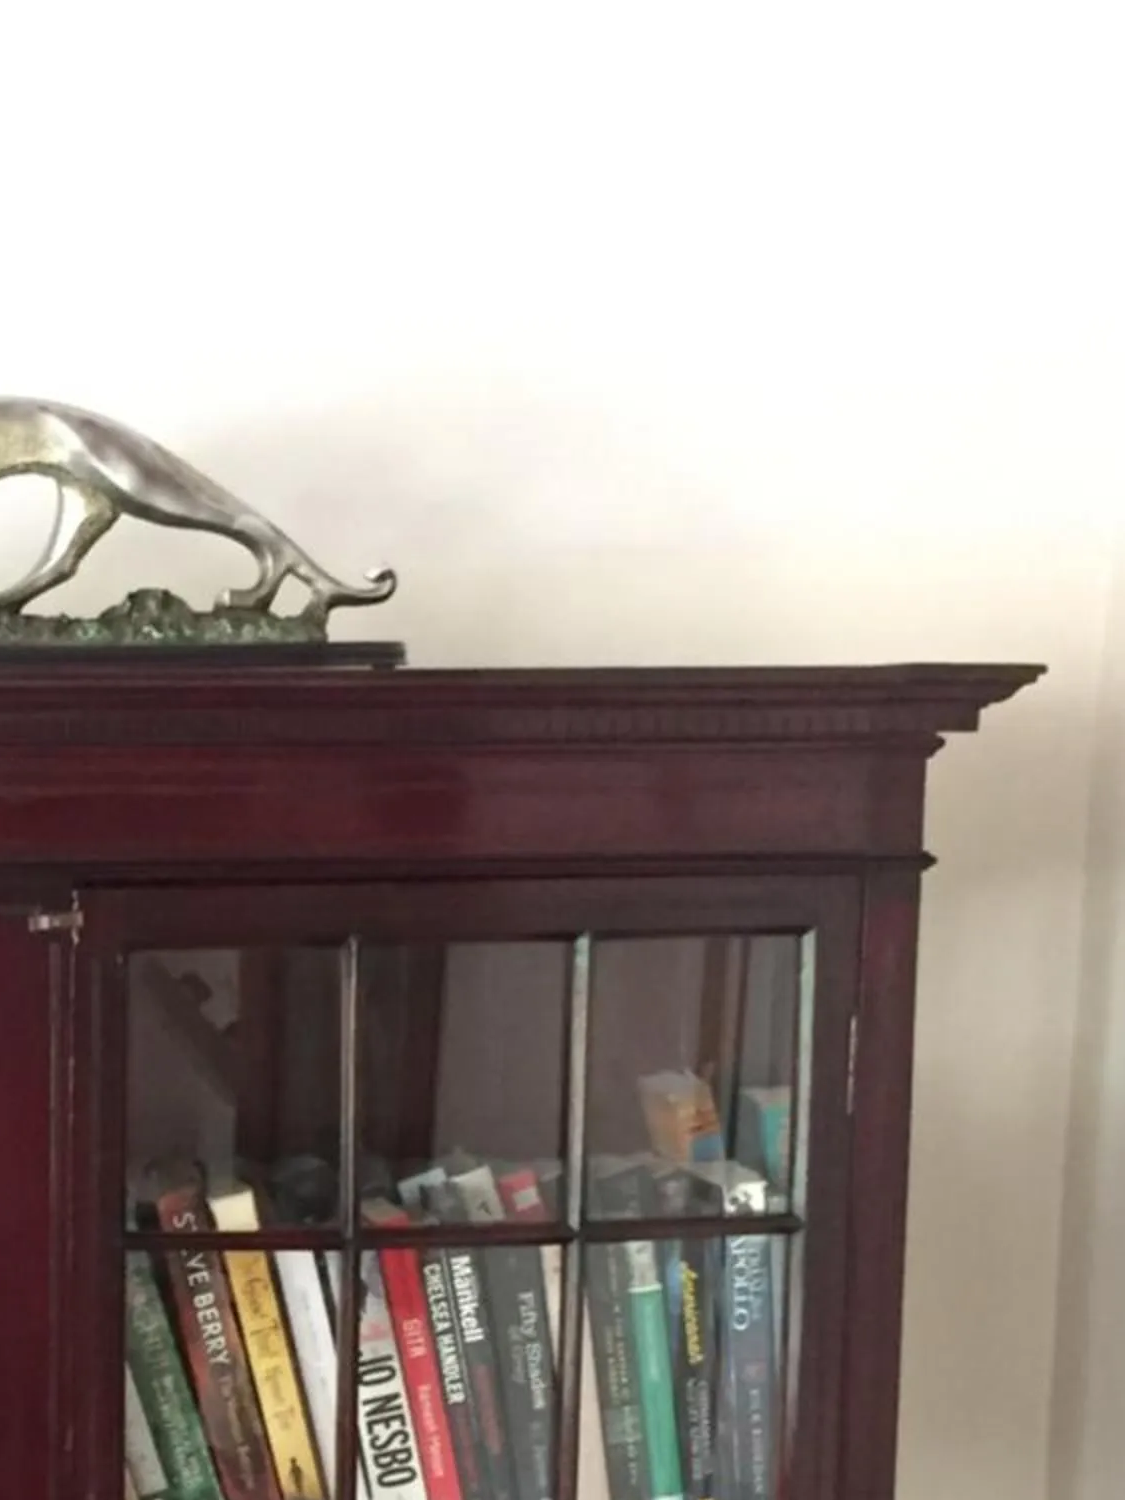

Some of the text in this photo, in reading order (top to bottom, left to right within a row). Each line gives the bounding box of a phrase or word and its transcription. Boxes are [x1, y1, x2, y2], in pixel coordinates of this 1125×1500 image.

[192, 1290, 231, 1367] BERRY
[421, 1261, 468, 1406] CHELSEA HANDLER
[449, 1254, 485, 1343] Mankell
[515, 1290, 540, 1337] Fifty
[402, 1316, 427, 1359] GITA
